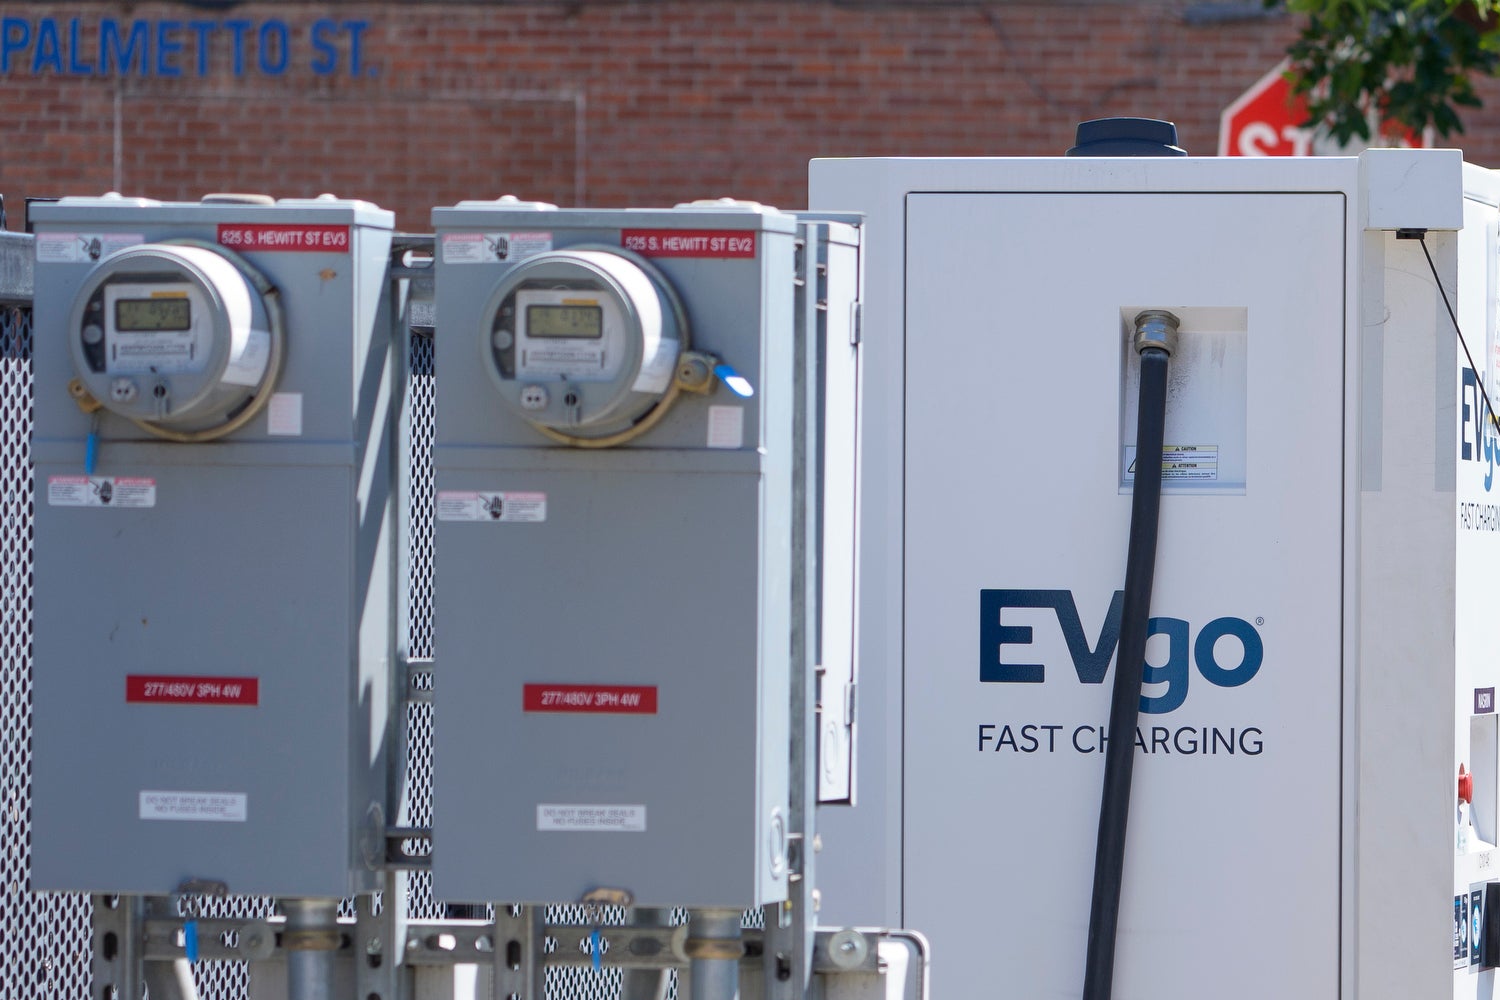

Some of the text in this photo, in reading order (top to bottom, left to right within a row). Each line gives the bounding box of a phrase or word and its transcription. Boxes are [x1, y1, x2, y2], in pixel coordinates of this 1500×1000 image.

[0, 17, 379, 78] PALMETTO ST.
[221, 230, 346, 247] 525 S. HEWITT ST EV3
[625, 235, 752, 252] 525 S. HEWITT ST EV2
[1461, 502, 1475, 530] FAST
[979, 588, 1264, 714] EVgo
[978, 724, 1063, 753] FAST
